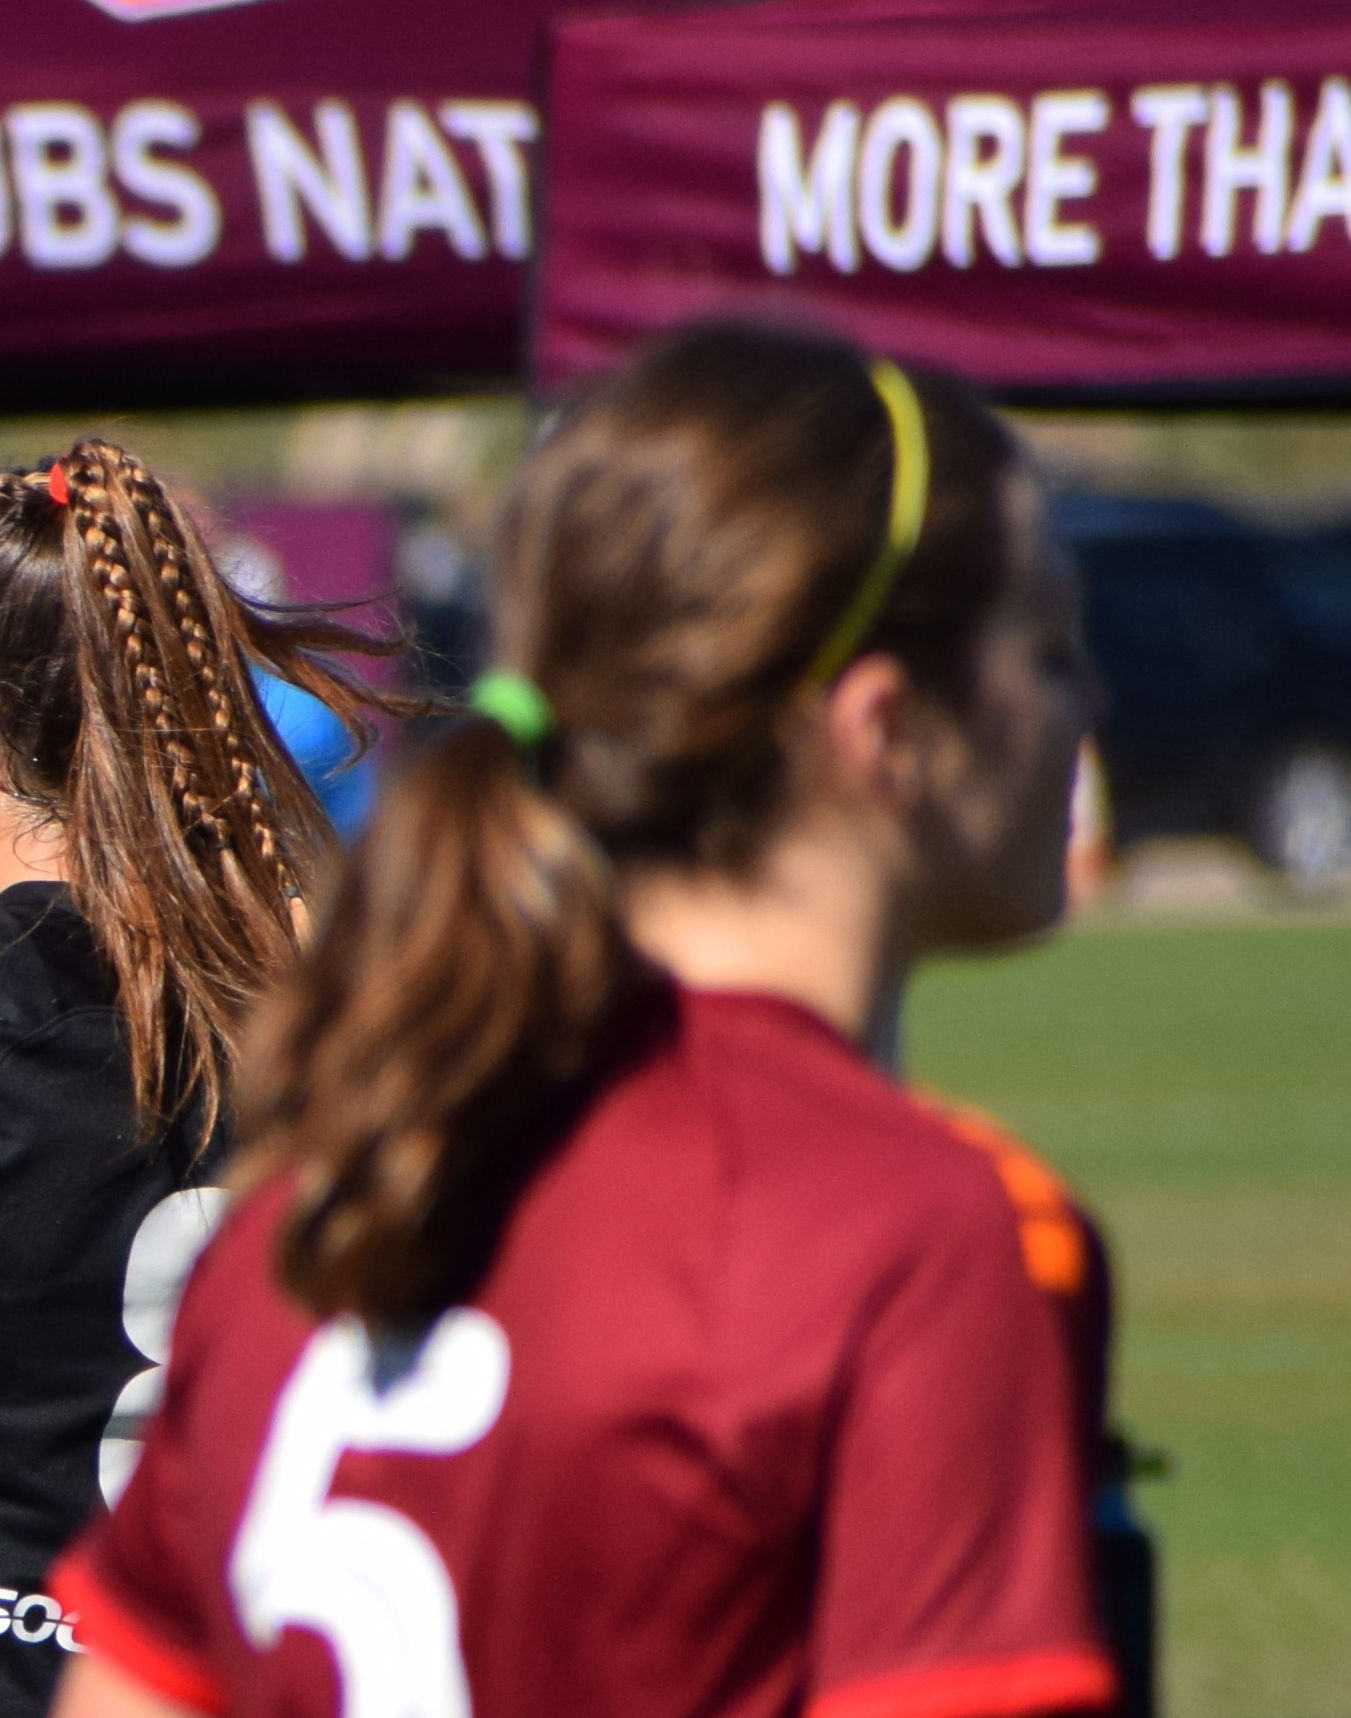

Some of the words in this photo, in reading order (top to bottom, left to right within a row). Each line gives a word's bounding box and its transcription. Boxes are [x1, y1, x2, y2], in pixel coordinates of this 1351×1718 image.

[249, 101, 535, 258] NAT
[758, 90, 1109, 272] MORE
[1132, 78, 1351, 259] THA
